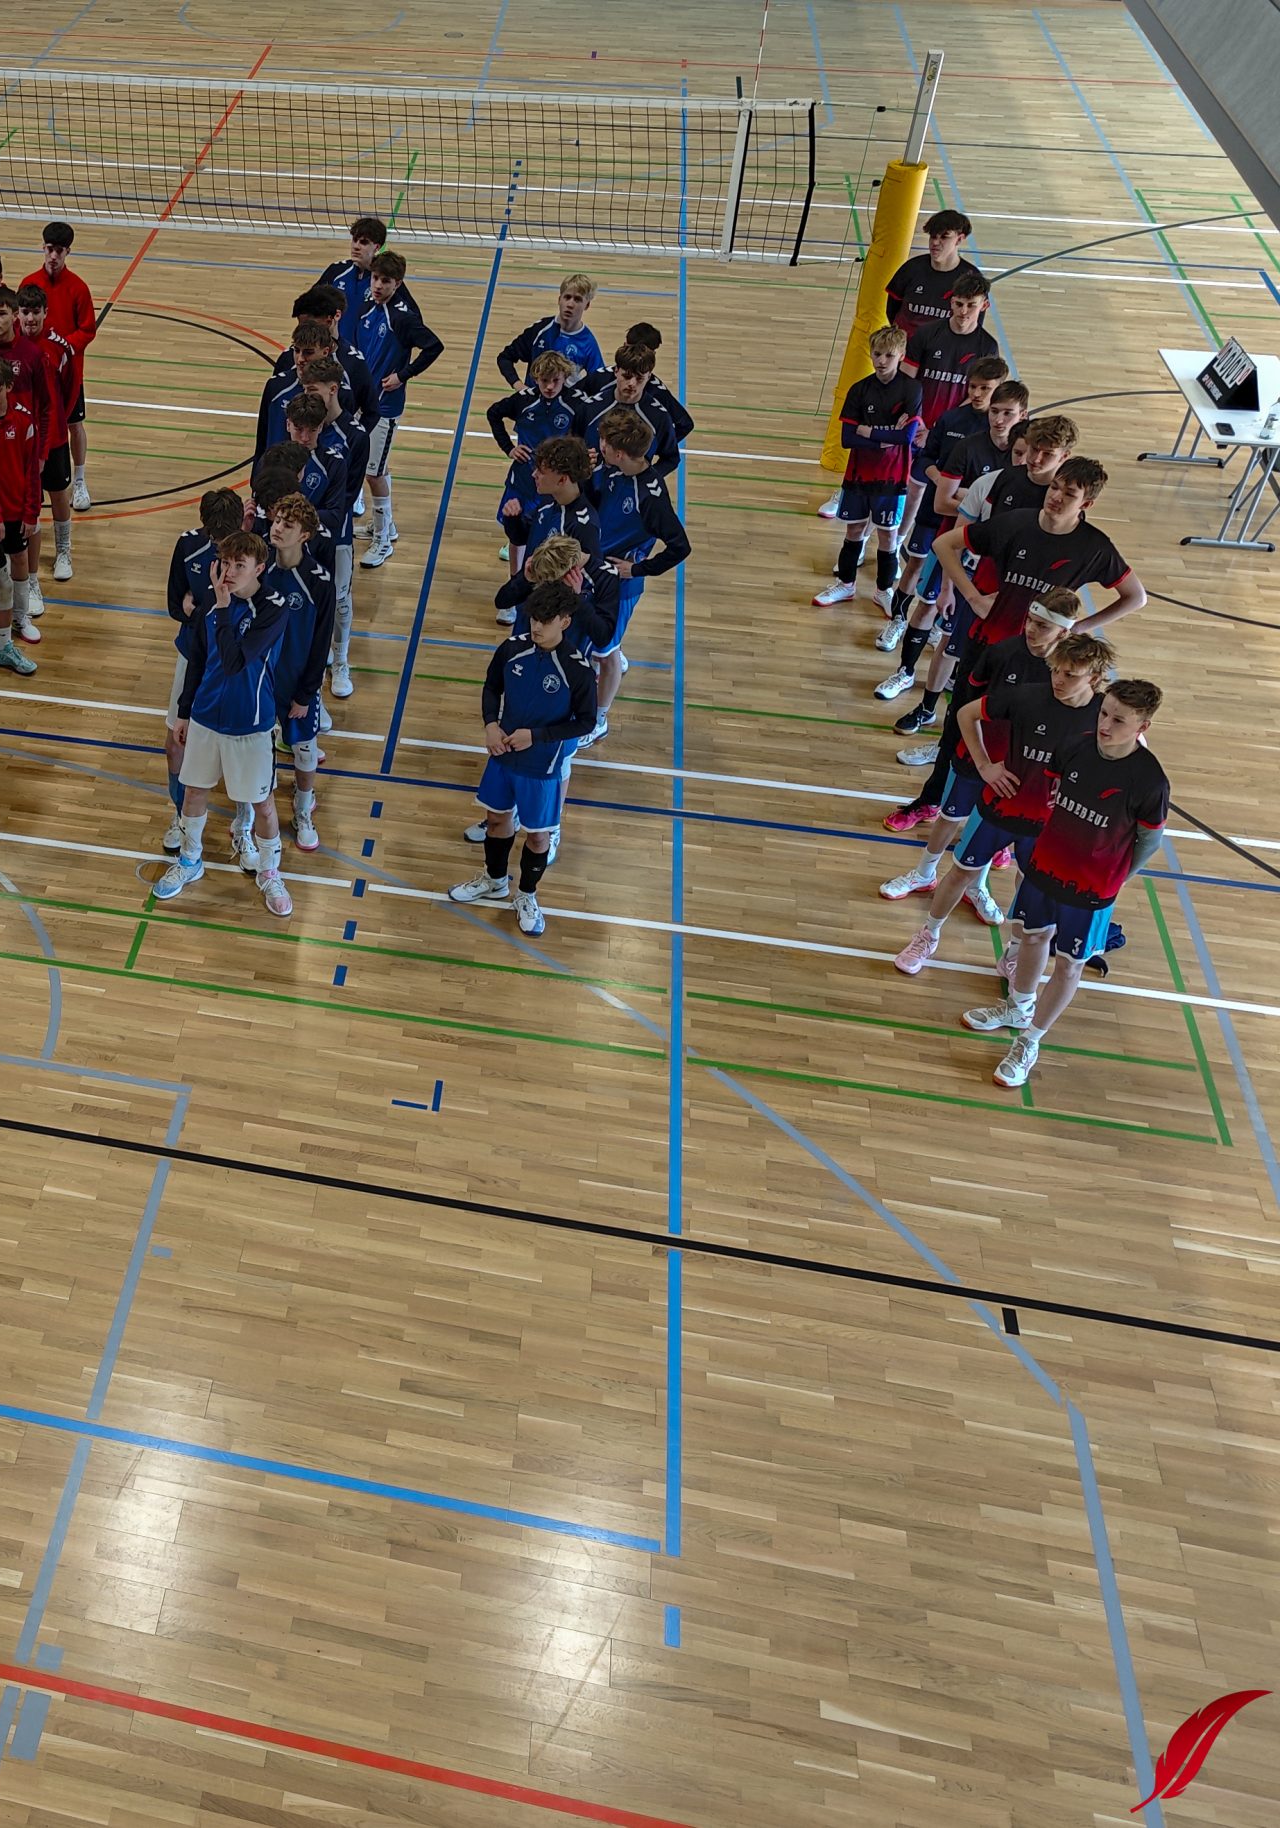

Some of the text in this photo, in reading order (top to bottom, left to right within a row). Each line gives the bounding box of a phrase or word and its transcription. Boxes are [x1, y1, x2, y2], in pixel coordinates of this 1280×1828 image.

[923, 368, 968, 385] RADEBEUL
[880, 510, 894, 525] 14
[1072, 937, 1083, 956] 3
